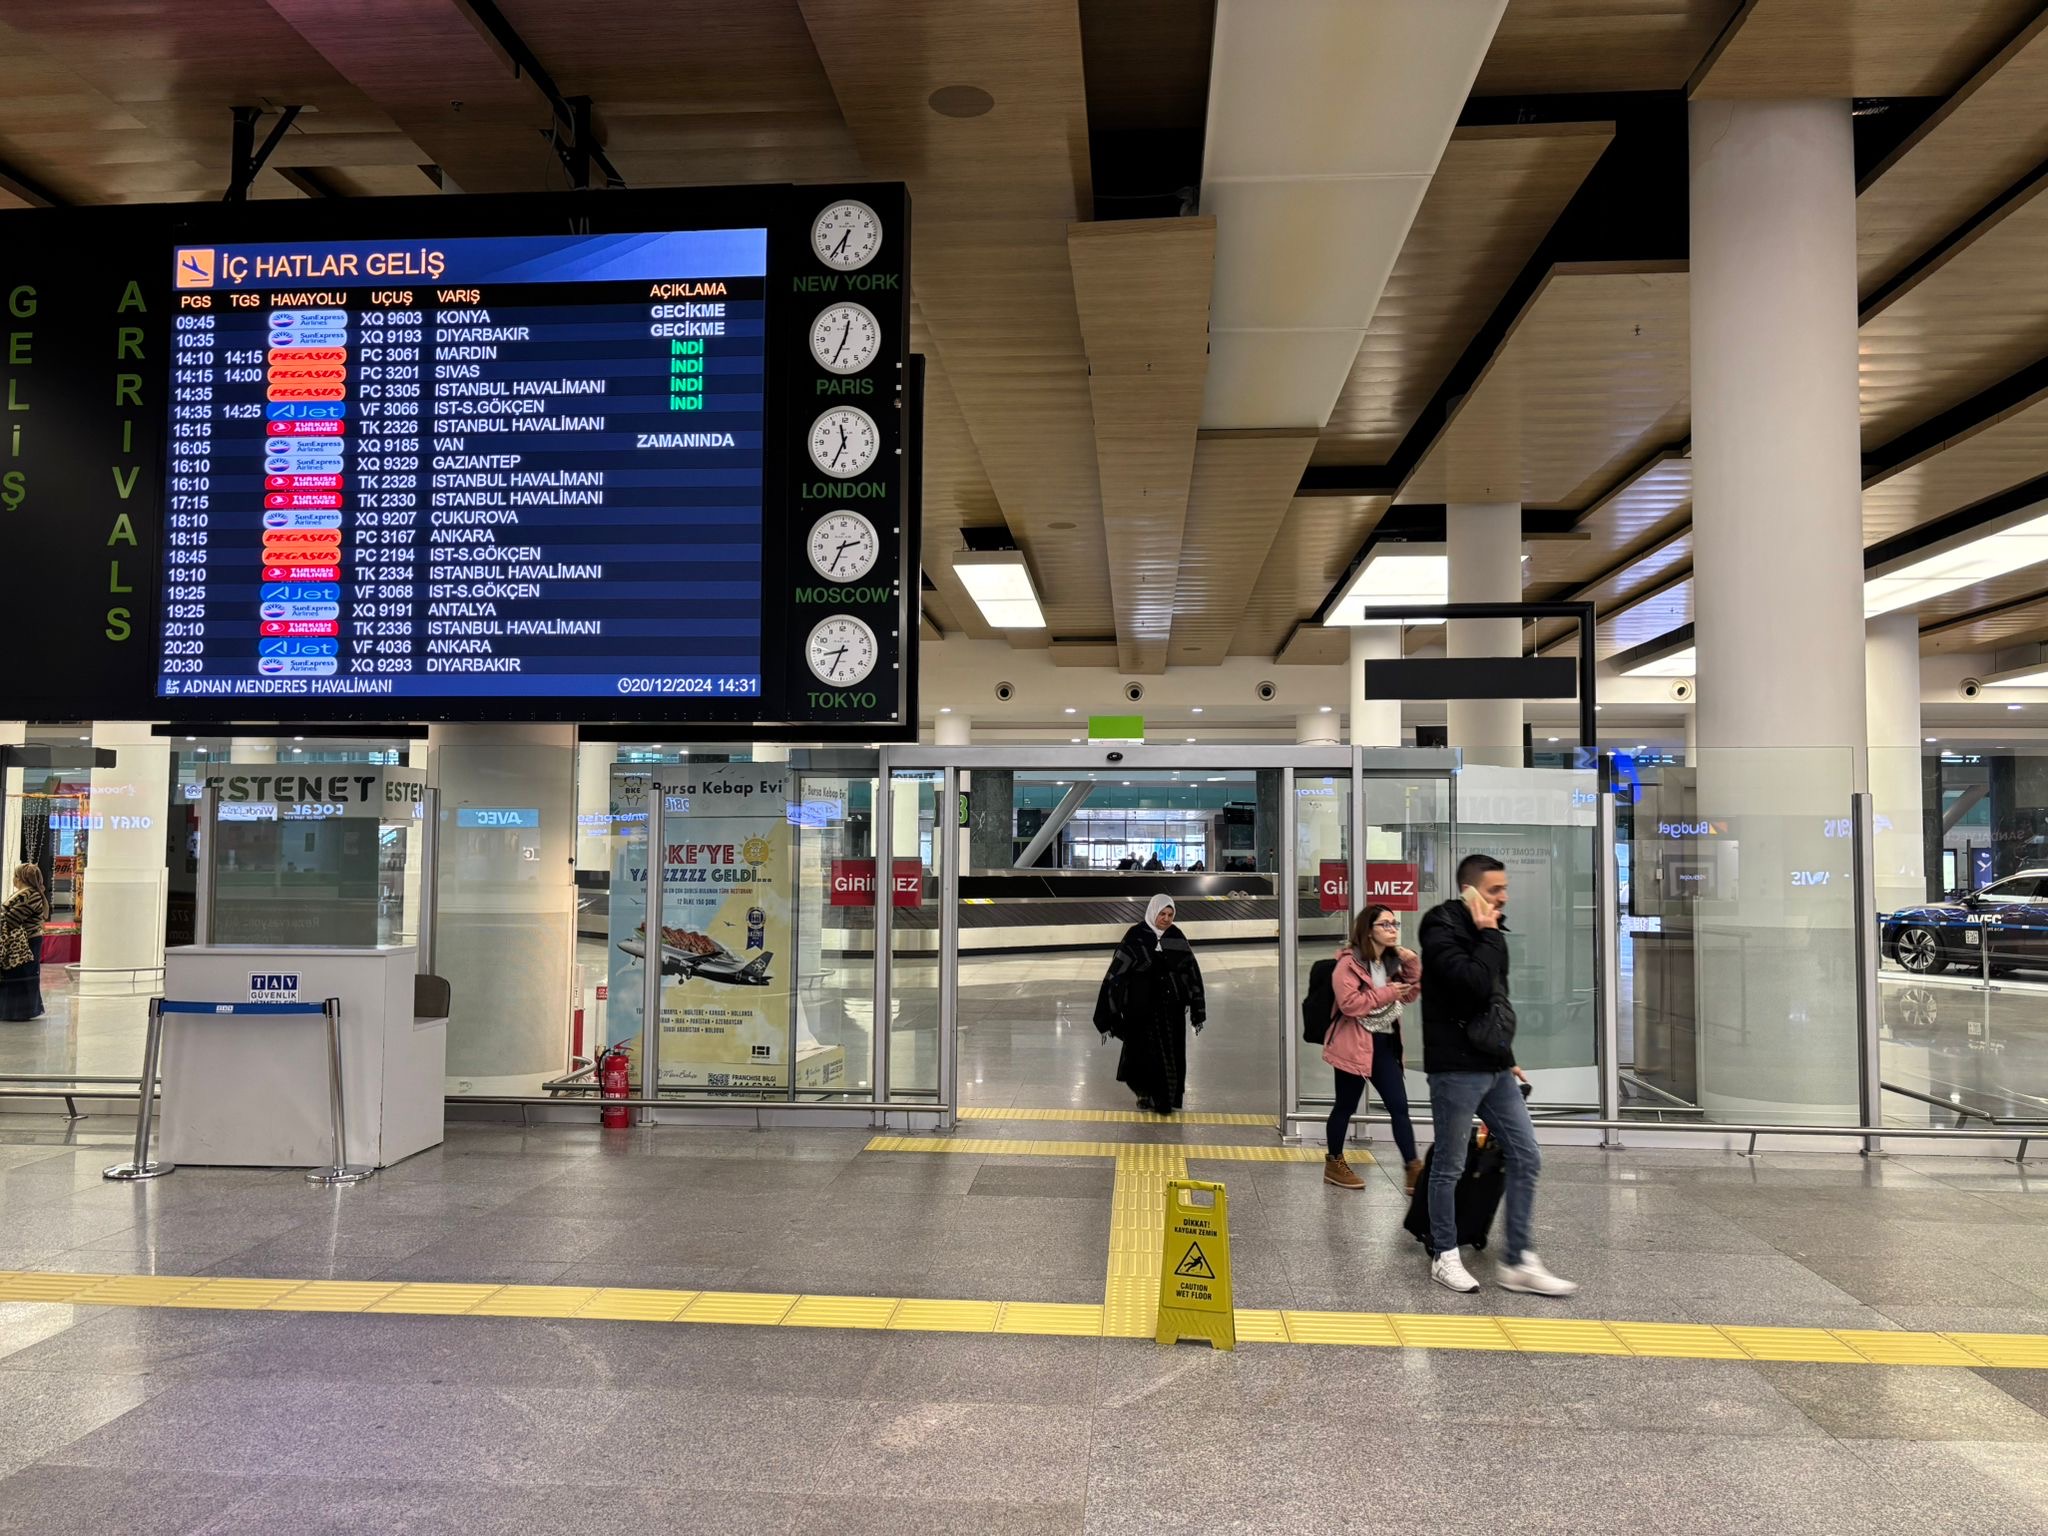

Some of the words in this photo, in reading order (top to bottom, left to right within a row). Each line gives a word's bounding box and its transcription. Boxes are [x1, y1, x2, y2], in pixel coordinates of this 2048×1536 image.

[222, 253, 248, 284] İÇ
[256, 254, 359, 278] HATLAR
[366, 247, 445, 280] GELİŞ
[793, 275, 839, 292] NEW
[843, 273, 900, 291] YORK
[181, 295, 212, 309] PGS
[230, 294, 260, 308] TGS
[271, 292, 347, 306] HAVAYOLU
[371, 290, 413, 307] UÇUŞ
[436, 289, 480, 305] VARIŞ
[649, 282, 727, 300] AÇIKLAMA
[176, 315, 215, 330] 09:45
[360, 311, 384, 326] XQ
[387, 311, 423, 326] 9603
[436, 309, 491, 324] KONYA
[650, 301, 726, 319] GECİKME
[176, 333, 215, 348] 10:35
[359, 330, 384, 344] XQ
[387, 329, 422, 344] 9193
[436, 326, 530, 343] DIYARBAKIR
[650, 320, 726, 337] GECİKME
[176, 351, 214, 366] 14:10
[224, 350, 263, 365] 14:15
[270, 352, 344, 361] PEGASUS
[360, 348, 383, 362] PC
[386, 347, 420, 362] 3061
[435, 345, 497, 361] MARDIN
[671, 338, 704, 355] İNDİ
[175, 369, 214, 384] 14:15
[224, 368, 263, 383] 14:00
[360, 366, 383, 380] PC
[385, 365, 419, 380] 3201
[434, 364, 480, 379] SIVAS
[670, 356, 704, 374] İNDİ
[174, 387, 213, 402] 14:35
[359, 384, 382, 399] PC
[385, 383, 421, 398] 3305
[435, 381, 510, 397] ISTANBUL
[512, 378, 606, 396] HAVALİMANI
[670, 375, 703, 392] İNDİ
[816, 378, 874, 395] PARIS
[174, 405, 212, 420] 14:35
[223, 404, 262, 419] 14:25
[359, 402, 381, 417] VF
[383, 401, 419, 416] 3066
[434, 397, 545, 416] IST-S.GÖKÇEN
[669, 393, 703, 411] İNDİ
[173, 423, 212, 437] 15:15
[359, 420, 380, 435] TK
[382, 419, 418, 434] 2326
[433, 418, 509, 433] ISTANBUL
[511, 413, 605, 432] HAVALİMANI
[172, 440, 211, 455] 16:05
[357, 438, 381, 453] XQ
[384, 438, 420, 453] 9185
[433, 437, 465, 452] VAN
[636, 432, 735, 448] ZAMANINDA
[105, 280, 148, 641] ARRIVALS
[172, 459, 211, 473] 16:10
[356, 457, 381, 471] XQ
[383, 456, 419, 471] 9329
[432, 454, 521, 470] GAZIANTEP
[171, 477, 210, 491] 16:10
[357, 475, 379, 489] TK
[381, 474, 417, 489] 2328
[432, 473, 508, 488] ISTANBUL
[510, 469, 604, 487] HAVALİMANI
[171, 495, 209, 510] 17:15
[357, 493, 378, 508] TK
[380, 493, 416, 508] 2330
[431, 491, 507, 507] ISTANBUL
[509, 488, 603, 506] HAVALİMANI
[802, 482, 886, 499] LONDON
[170, 513, 209, 528] 18:10
[355, 511, 379, 526] XQ
[381, 511, 417, 526] 9207
[430, 510, 519, 527] ÇUKUROVA
[169, 531, 208, 546] 18:15
[355, 530, 378, 545] PC
[380, 529, 416, 544] 3167
[430, 528, 496, 543] ANKARA
[169, 549, 207, 564] 18:45
[355, 548, 377, 563] PC
[379, 547, 416, 562] 2194
[430, 544, 541, 563] IST-S.GÖKÇEN
[168, 567, 207, 582] 19:10
[354, 566, 376, 581] TK
[378, 566, 414, 581] 2334
[429, 565, 505, 580] ISTANBUL
[508, 562, 602, 579] HAVALİMANI
[167, 585, 206, 600] 19:25
[354, 584, 376, 599] VF
[378, 584, 414, 599] 3068
[429, 581, 540, 600] IST-S.GÖKÇEN
[795, 587, 890, 604] MOSCOW
[167, 604, 205, 618] 19:25
[352, 603, 376, 618] XQ
[378, 602, 412, 617] 9191
[427, 602, 497, 617] ANTALYA
[164, 622, 205, 637] 20:10
[353, 621, 374, 636] TK
[376, 621, 412, 636] 2336
[427, 620, 504, 635] ISTANBUL
[506, 618, 601, 635] HAVALİMANI
[164, 640, 204, 655] 20:20
[352, 639, 374, 654] VF
[375, 639, 412, 654] 4036
[426, 639, 493, 654] ANKARA
[163, 658, 204, 673] 20:30
[350, 657, 375, 673] XQ
[377, 658, 413, 672] 9293
[426, 657, 521, 672] DIYARBAKIR
[183, 679, 231, 694] ADNAN
[235, 679, 307, 693] MENDERES
[311, 676, 392, 693] HAVALİMANI
[631, 678, 712, 693] 20/12/2024
[717, 678, 757, 693] 14:31
[807, 692, 877, 709] TOKYO
[625, 787, 641, 795] BKE
[653, 782, 697, 795] Bursa
[702, 781, 754, 798] Kebap
[760, 780, 782, 794] Evi
[664, 844, 735, 865] KE'YE
[253, 976, 297, 989] TAV
[250, 990, 298, 999] GÜVENLİK
[1183, 1217, 1210, 1228] DİKKAT!
[1176, 1290, 1189, 1298] WET
[1191, 1291, 1212, 1300] FLOOR
[1180, 1282, 1208, 1291] CAUTION
